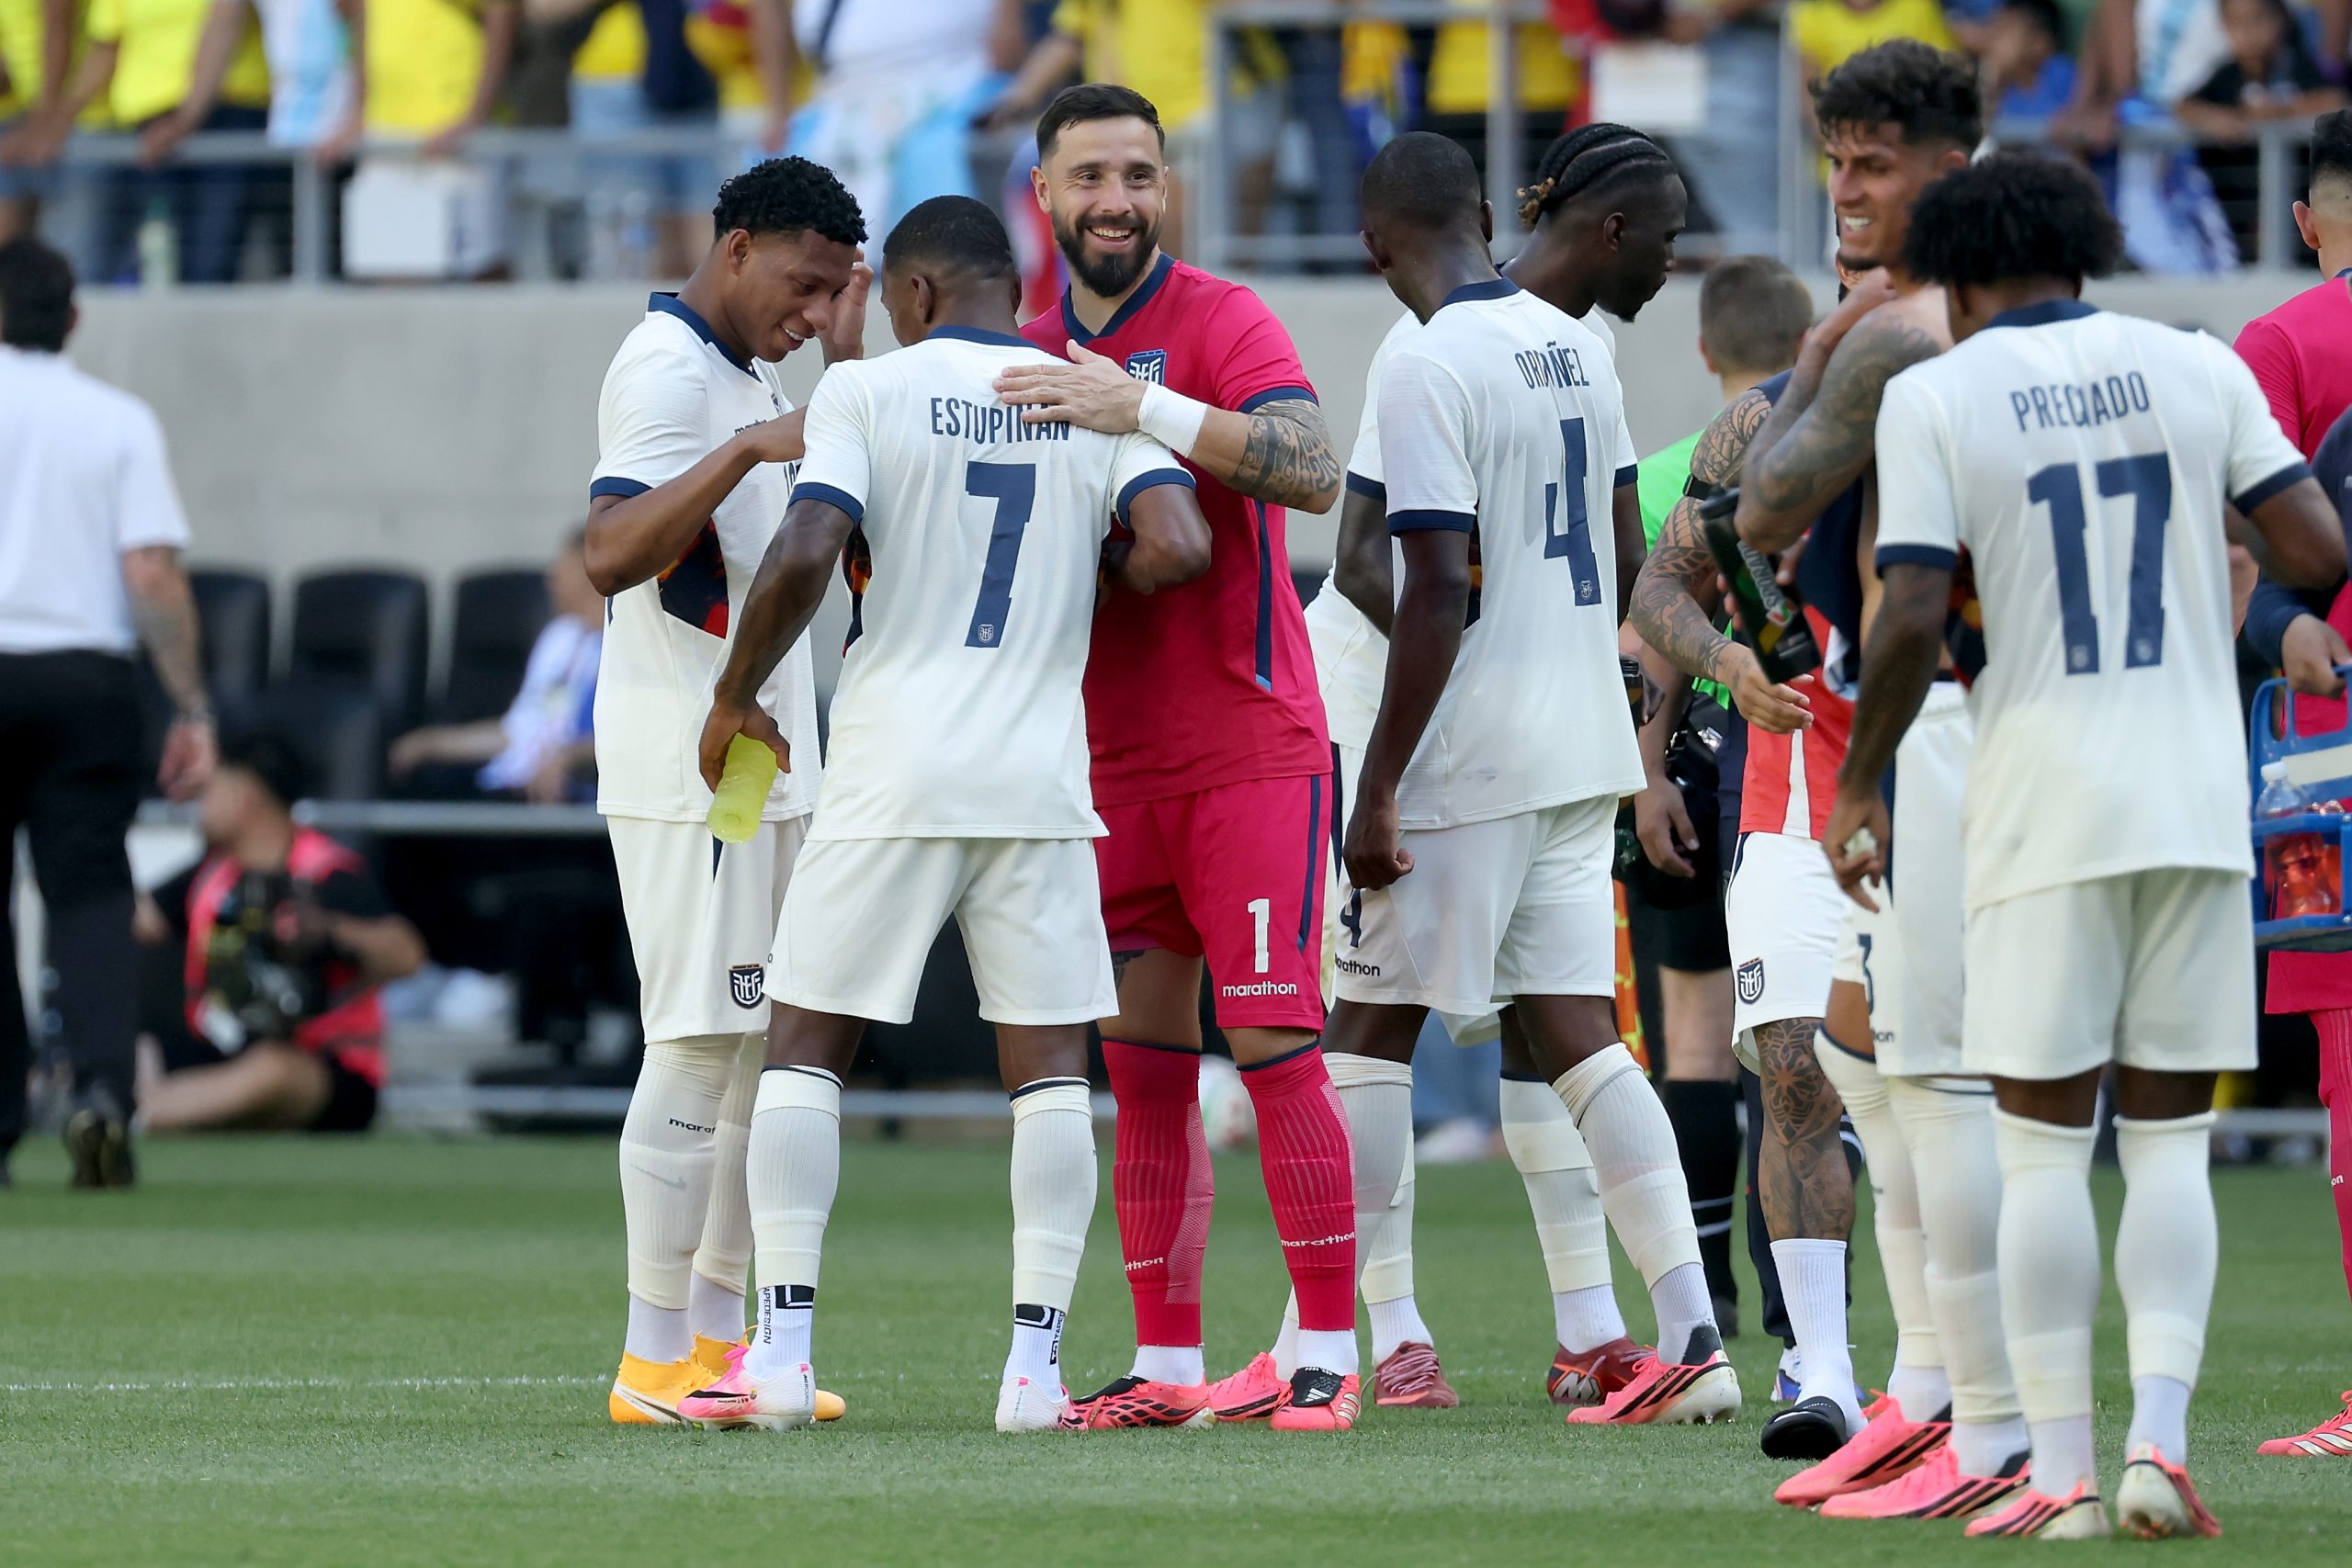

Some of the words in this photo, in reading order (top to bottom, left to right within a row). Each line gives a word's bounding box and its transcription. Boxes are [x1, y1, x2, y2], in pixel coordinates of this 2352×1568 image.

[1544, 417, 1602, 606] 4
[964, 460, 1036, 648] 7
[2027, 451, 2172, 674] 17
[1247, 898, 1270, 974] 1
[1340, 888, 1362, 948] 4
[1222, 980, 1297, 998] marathon
[1280, 1231, 1355, 1247] marathon
